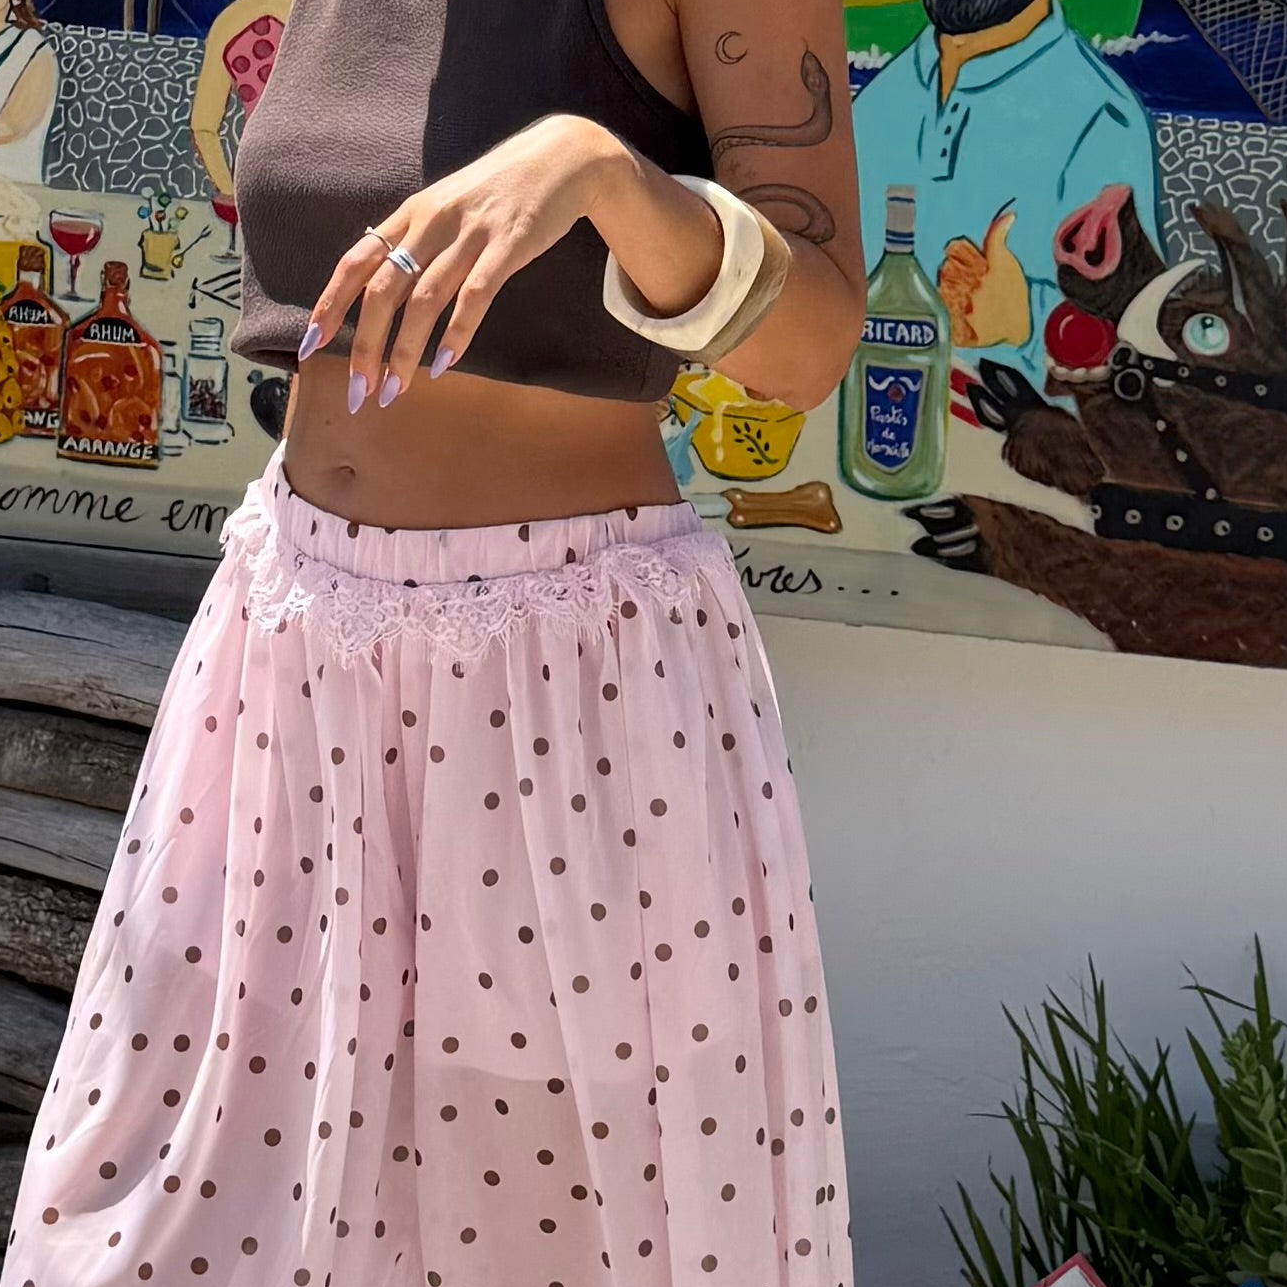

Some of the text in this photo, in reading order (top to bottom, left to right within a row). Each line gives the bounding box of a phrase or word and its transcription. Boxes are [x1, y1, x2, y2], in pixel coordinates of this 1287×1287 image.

[89, 323, 135, 342] RHUM
[861, 320, 935, 345] RICARD
[881, 427, 896, 441] de
